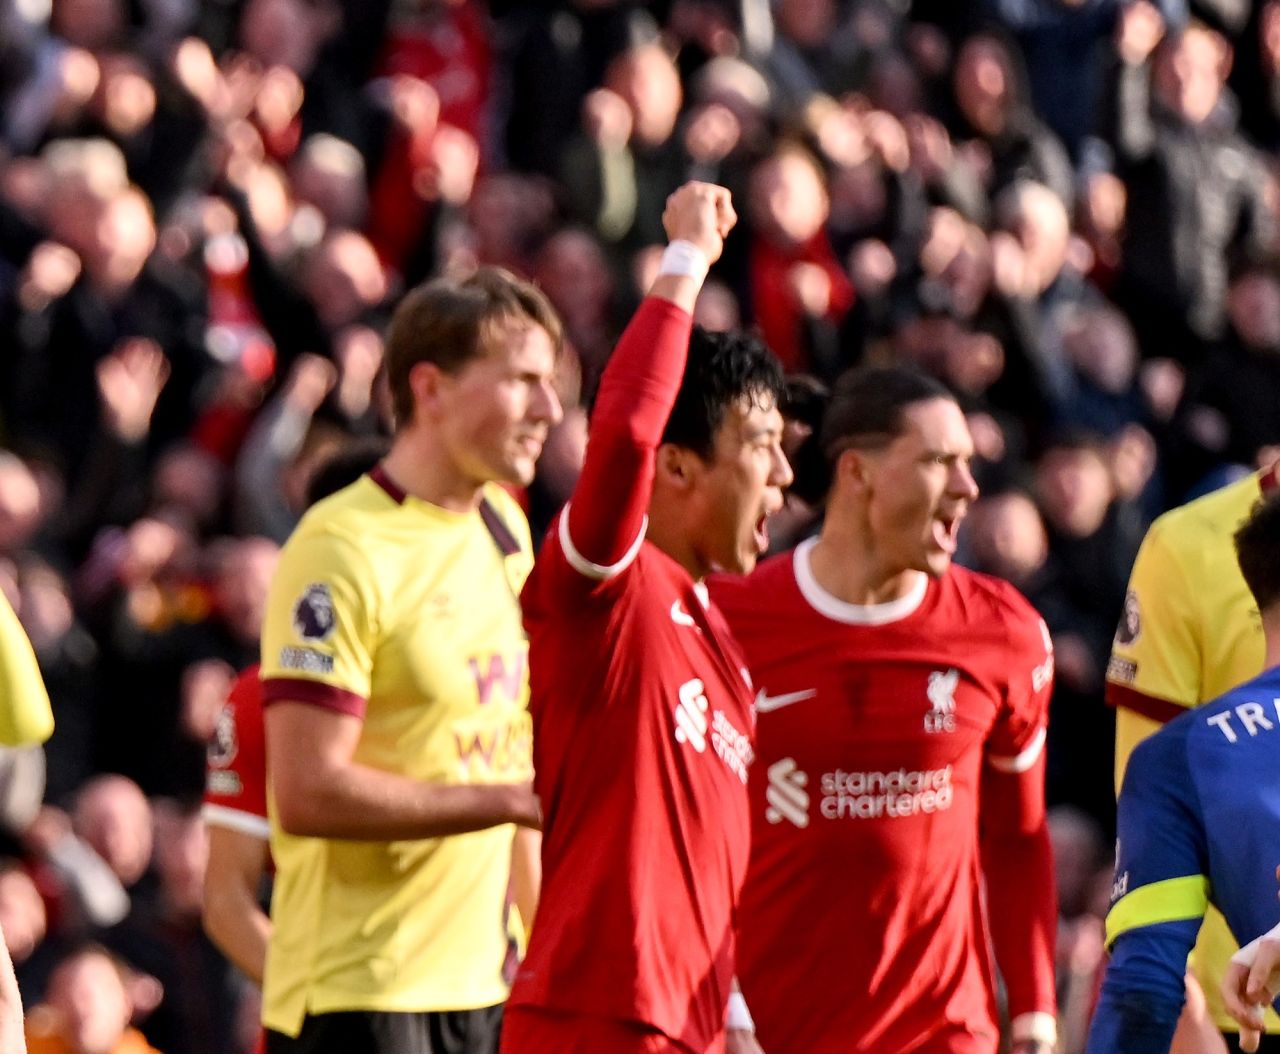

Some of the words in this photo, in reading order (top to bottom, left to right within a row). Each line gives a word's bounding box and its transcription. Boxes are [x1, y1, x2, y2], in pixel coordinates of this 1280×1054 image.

[1206, 697, 1280, 743] TR
[820, 763, 953, 796] standard
[820, 783, 954, 819] chartered
